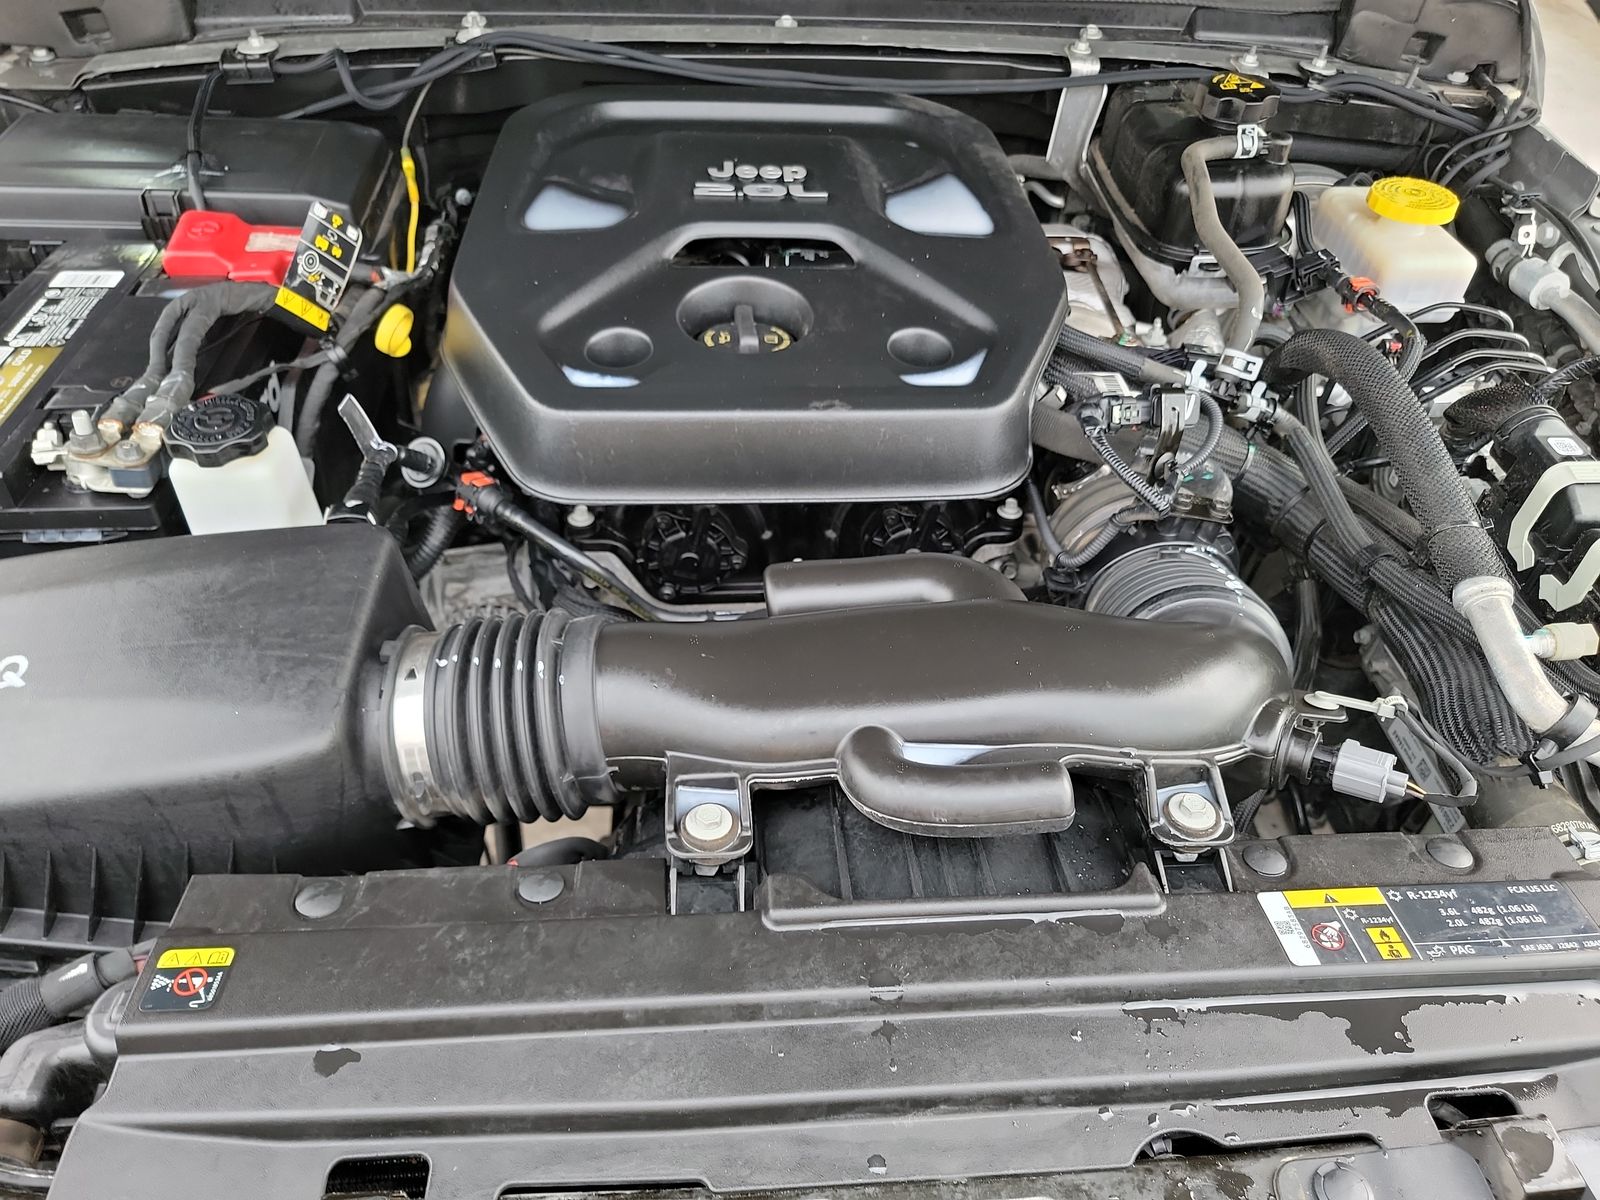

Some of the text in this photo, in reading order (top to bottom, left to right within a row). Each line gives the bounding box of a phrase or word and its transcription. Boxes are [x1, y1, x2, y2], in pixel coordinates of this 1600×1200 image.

[707, 160, 807, 182] Jeep
[693, 182, 829, 199] 2.0L
[1406, 889, 1459, 902] R-1234yf
[1507, 884, 1558, 894] FCA US LLC
[1438, 907, 1460, 916] 3.6L
[1471, 907, 1496, 916] 482g
[1496, 905, 1522, 914] (1.06
[1521, 904, 1538, 913] Lb)
[1446, 919, 1468, 927] 2.0L
[1479, 917, 1504, 926] 482g
[1504, 916, 1530, 926] (1.06
[1529, 914, 1547, 924] Lb)
[1450, 945, 1476, 956] PAG
